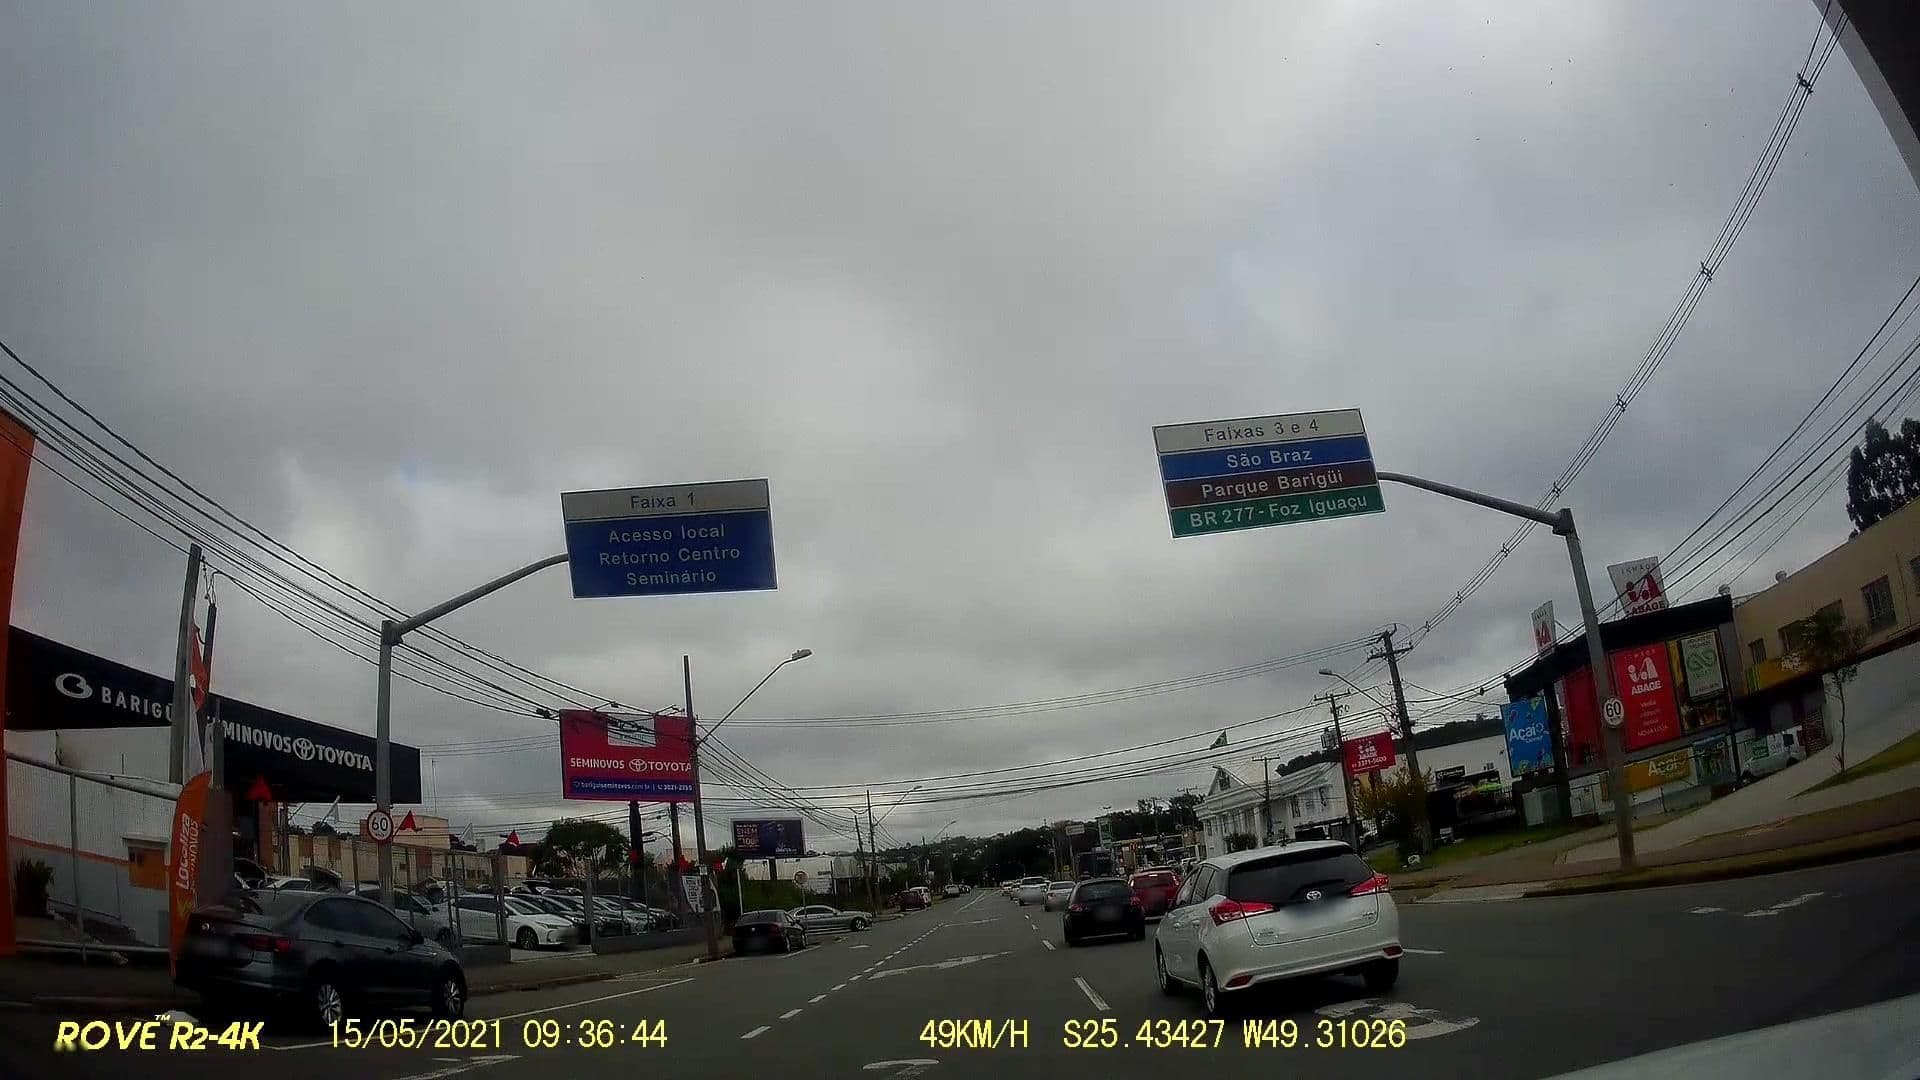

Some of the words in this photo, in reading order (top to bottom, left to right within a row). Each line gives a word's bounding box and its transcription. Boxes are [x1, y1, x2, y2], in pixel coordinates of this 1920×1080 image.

[1204, 426, 1265, 442] Faixas
[1275, 422, 1284, 434] 3
[1291, 423, 1300, 433] e
[1309, 418, 1320, 431] 4
[1226, 452, 1262, 469] São
[1269, 450, 1313, 464] Braz
[1201, 480, 1269, 498] Parque
[1277, 468, 1343, 489] Barigüi
[631, 494, 676, 509] Faixa
[688, 492, 695, 506] 1
[1189, 511, 1218, 528] BR
[1309, 495, 1367, 515] Iguaçu
[608, 529, 673, 544] Acesso
[681, 523, 725, 539] local
[600, 551, 670, 566] Retorno
[678, 547, 740, 562] Centro
[626, 569, 717, 586] Seminário
[1606, 701, 1621, 717] 60
[316, 745, 374, 772] TOYOTA
[570, 757, 625, 769] SEMINOVOS
[648, 761, 692, 772] TOYOTA
[372, 817, 388, 831] 60
